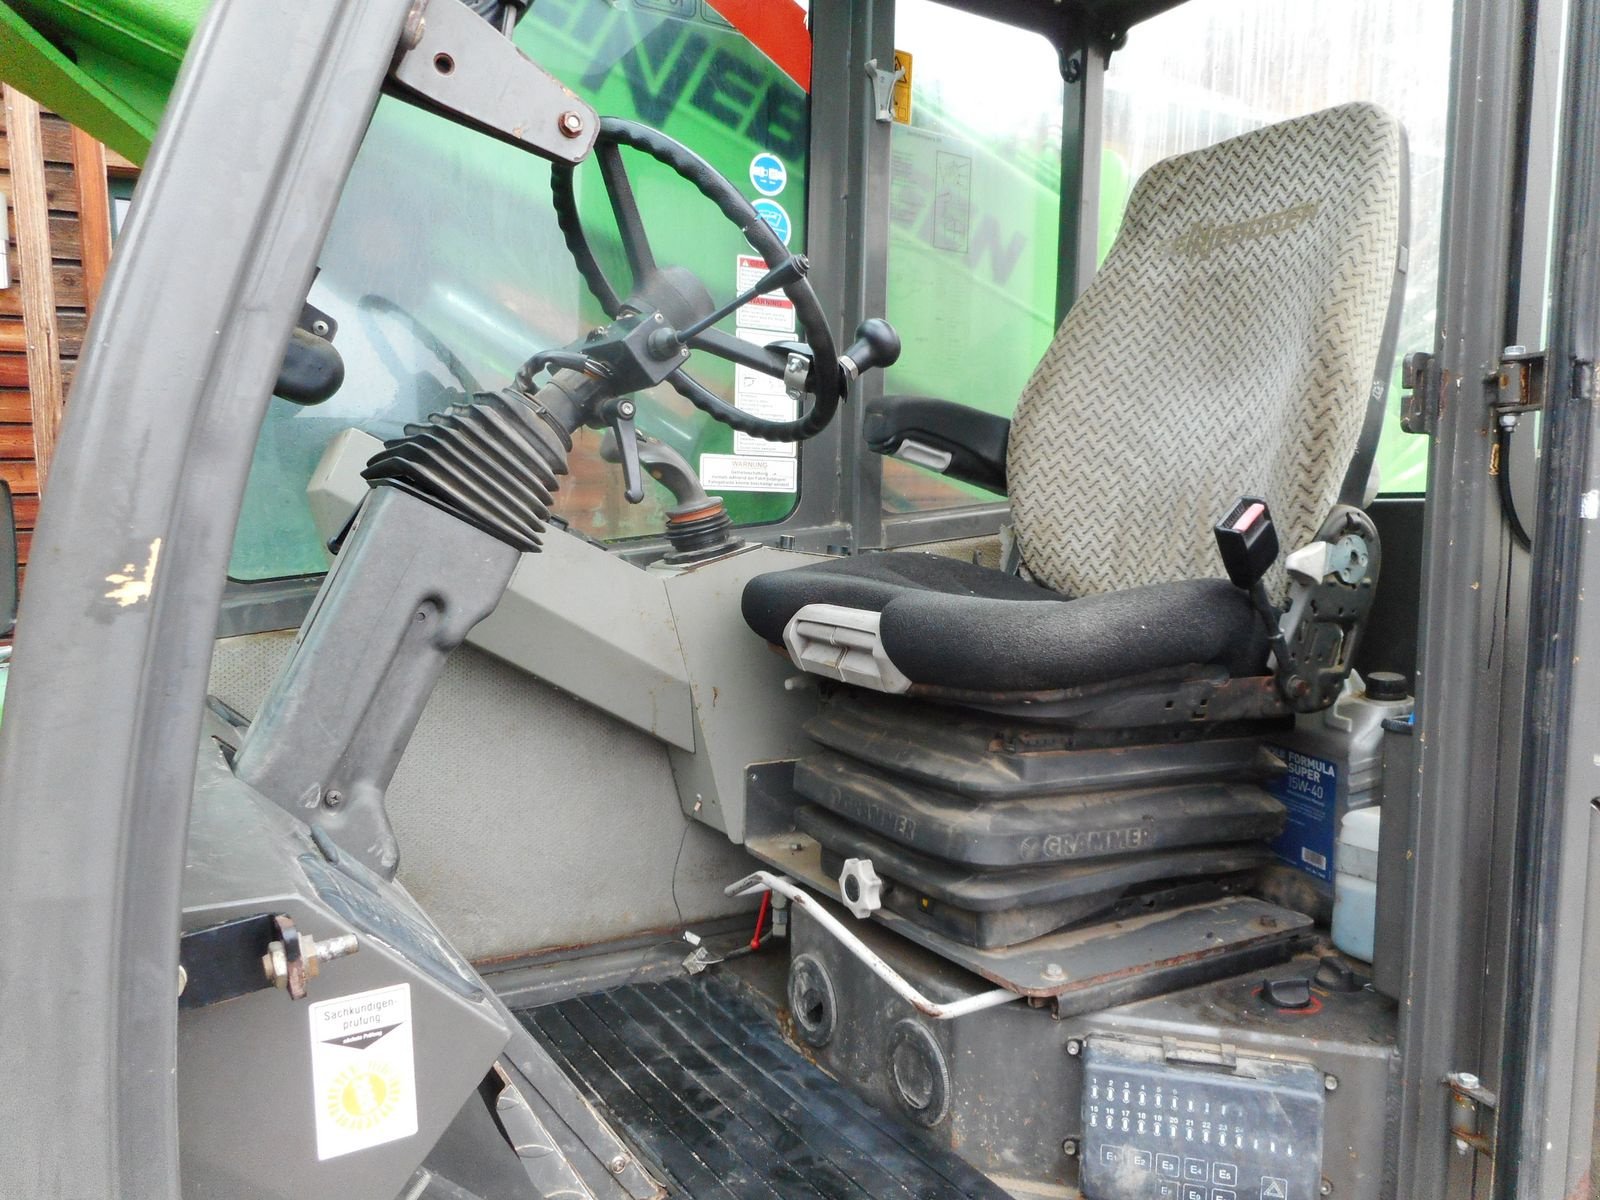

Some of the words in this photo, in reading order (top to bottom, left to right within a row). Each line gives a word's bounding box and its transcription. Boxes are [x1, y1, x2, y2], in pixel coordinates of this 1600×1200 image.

[1288, 751, 1335, 777] FORMULA
[1288, 763, 1320, 783] SUPER
[1288, 776, 1324, 799] 15W-40
[1043, 828, 1153, 858] GRAMMER
[1106, 1152, 1117, 1161] E1
[1134, 1156, 1146, 1166] E2
[1162, 1160, 1174, 1170] E3
[1190, 1165, 1202, 1175] E4
[1219, 1169, 1231, 1180] E5
